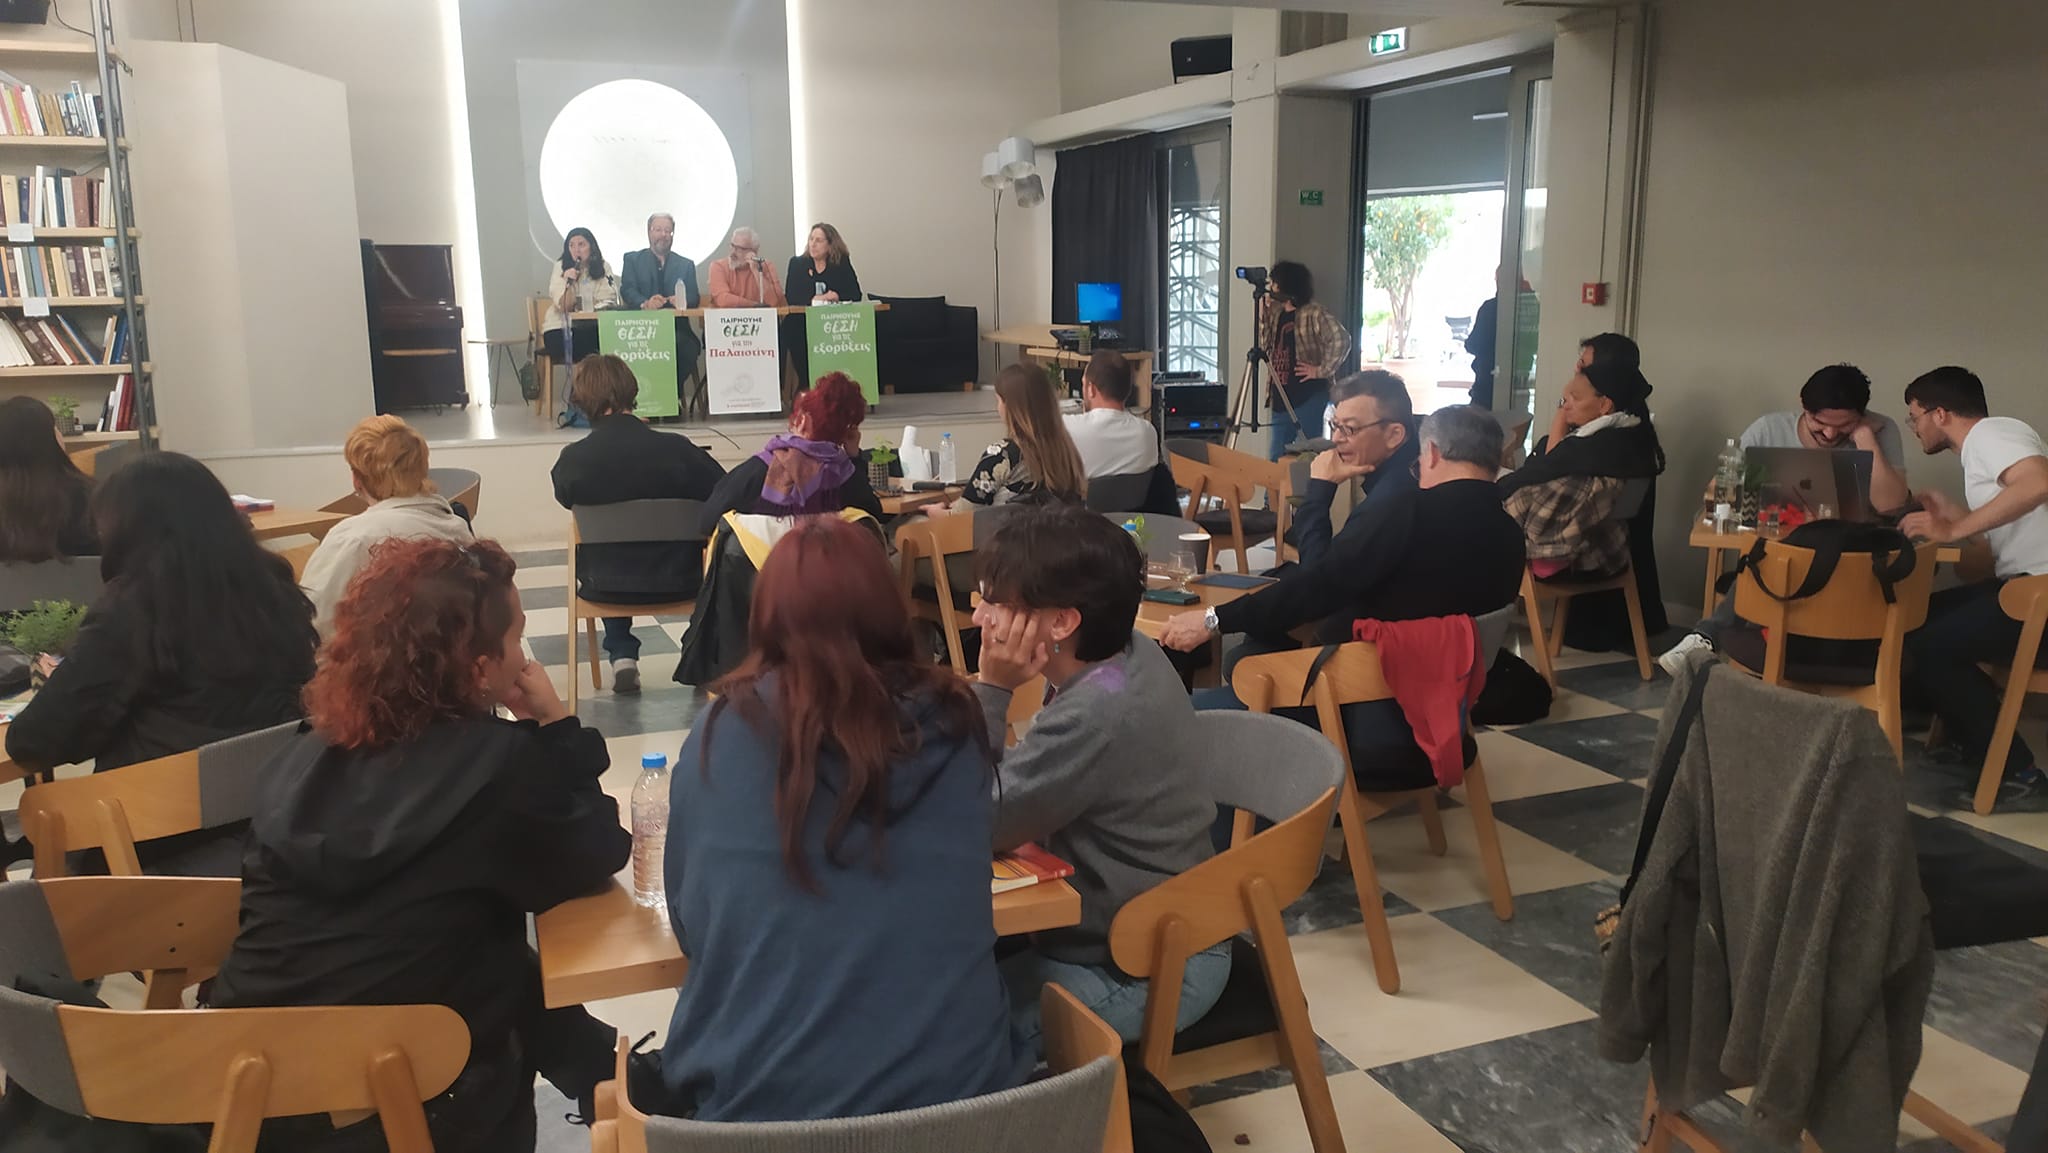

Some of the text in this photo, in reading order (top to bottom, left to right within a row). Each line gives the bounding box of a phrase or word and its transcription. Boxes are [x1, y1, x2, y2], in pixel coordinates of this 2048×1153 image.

[617, 326, 657, 340] ΘΕΣΗ
[723, 324, 760, 338] ΘΕΣΗ
[823, 320, 859, 334] ΘΕΣΗ
[613, 348, 671, 362] ορύξεις
[709, 348, 775, 358] Παλαιστίνη
[813, 341, 871, 355] εξορύξεις
